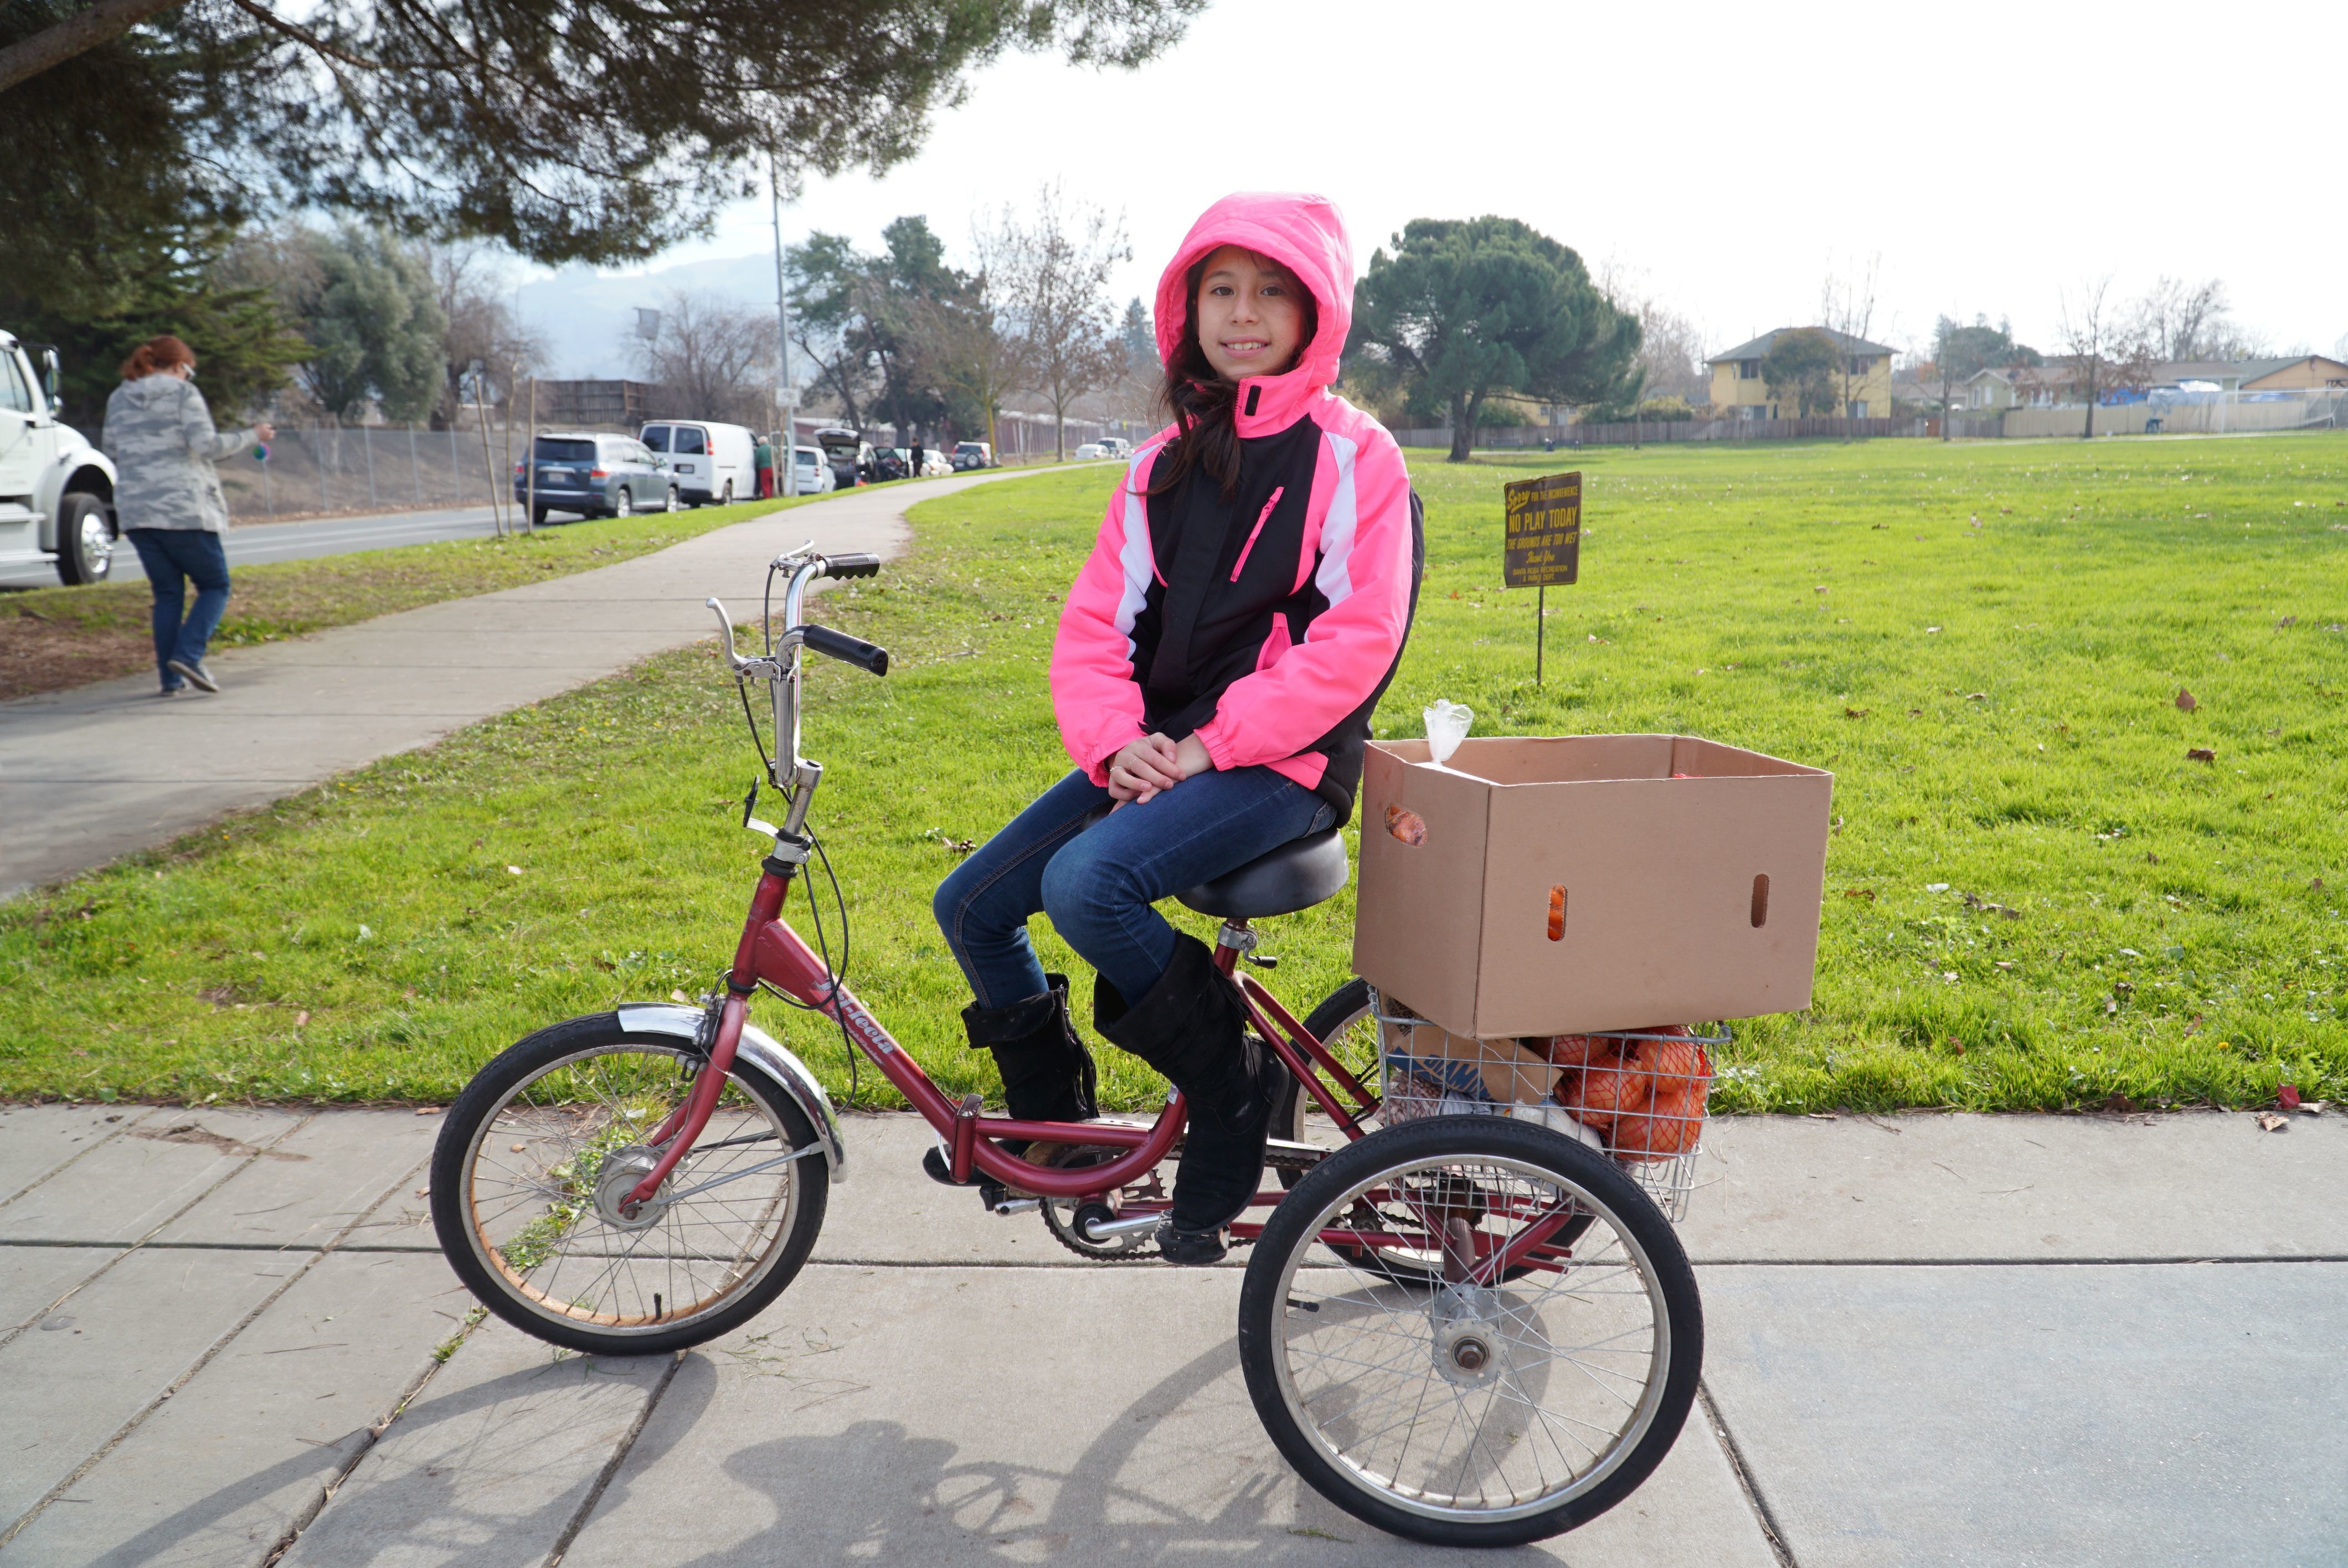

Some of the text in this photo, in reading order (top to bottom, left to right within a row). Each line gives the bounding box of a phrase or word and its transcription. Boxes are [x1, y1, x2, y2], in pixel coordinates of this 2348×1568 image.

[1507, 488, 1530, 513] Sorry
[1548, 486, 1578, 499] INCONVENIENCE
[1509, 505, 1578, 533] NO PLAY TODAY
[1507, 532, 1578, 550] THE GROUNDS ARE TOO WET
[1526, 550, 1556, 565] Thank You
[1512, 568, 1526, 576] SANTA
[1541, 564, 1568, 574] RECREATION
